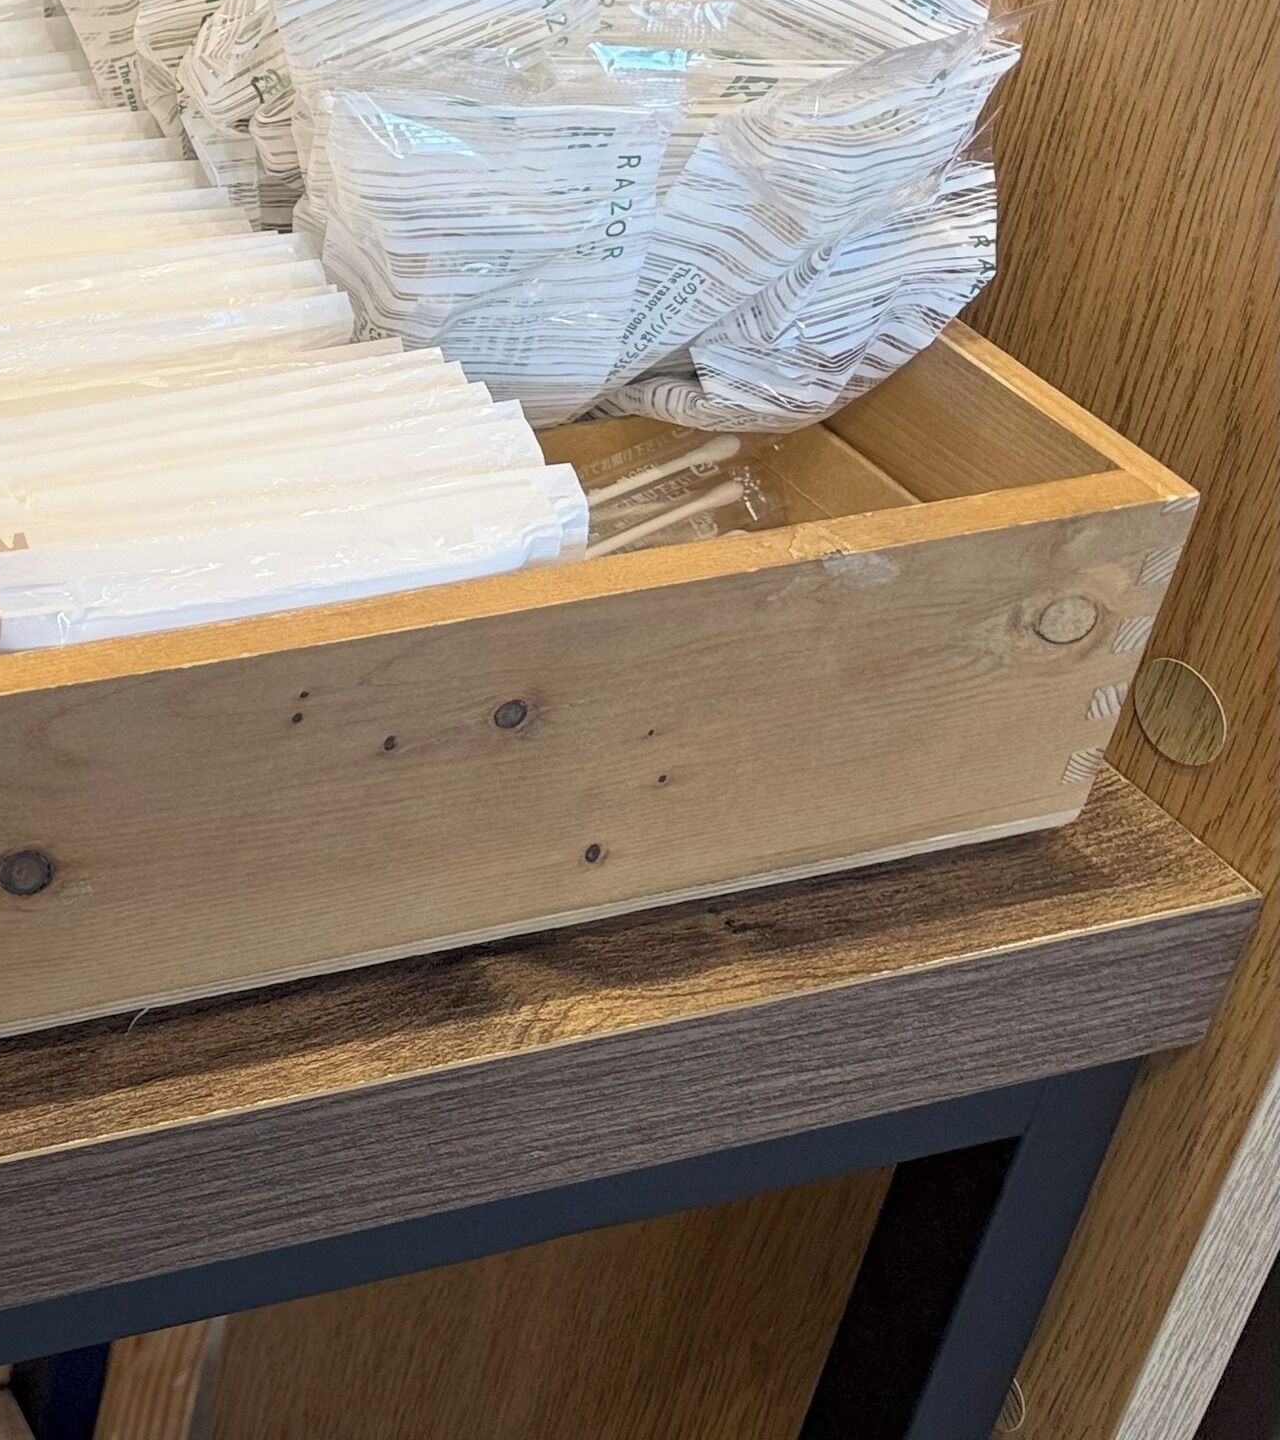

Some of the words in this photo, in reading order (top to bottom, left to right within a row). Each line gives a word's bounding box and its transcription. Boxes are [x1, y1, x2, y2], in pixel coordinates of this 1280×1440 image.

[119, 61, 132, 84] The
[601, 155, 641, 260] RAZOR
[666, 261, 691, 286] The
[643, 283, 670, 314] razor
